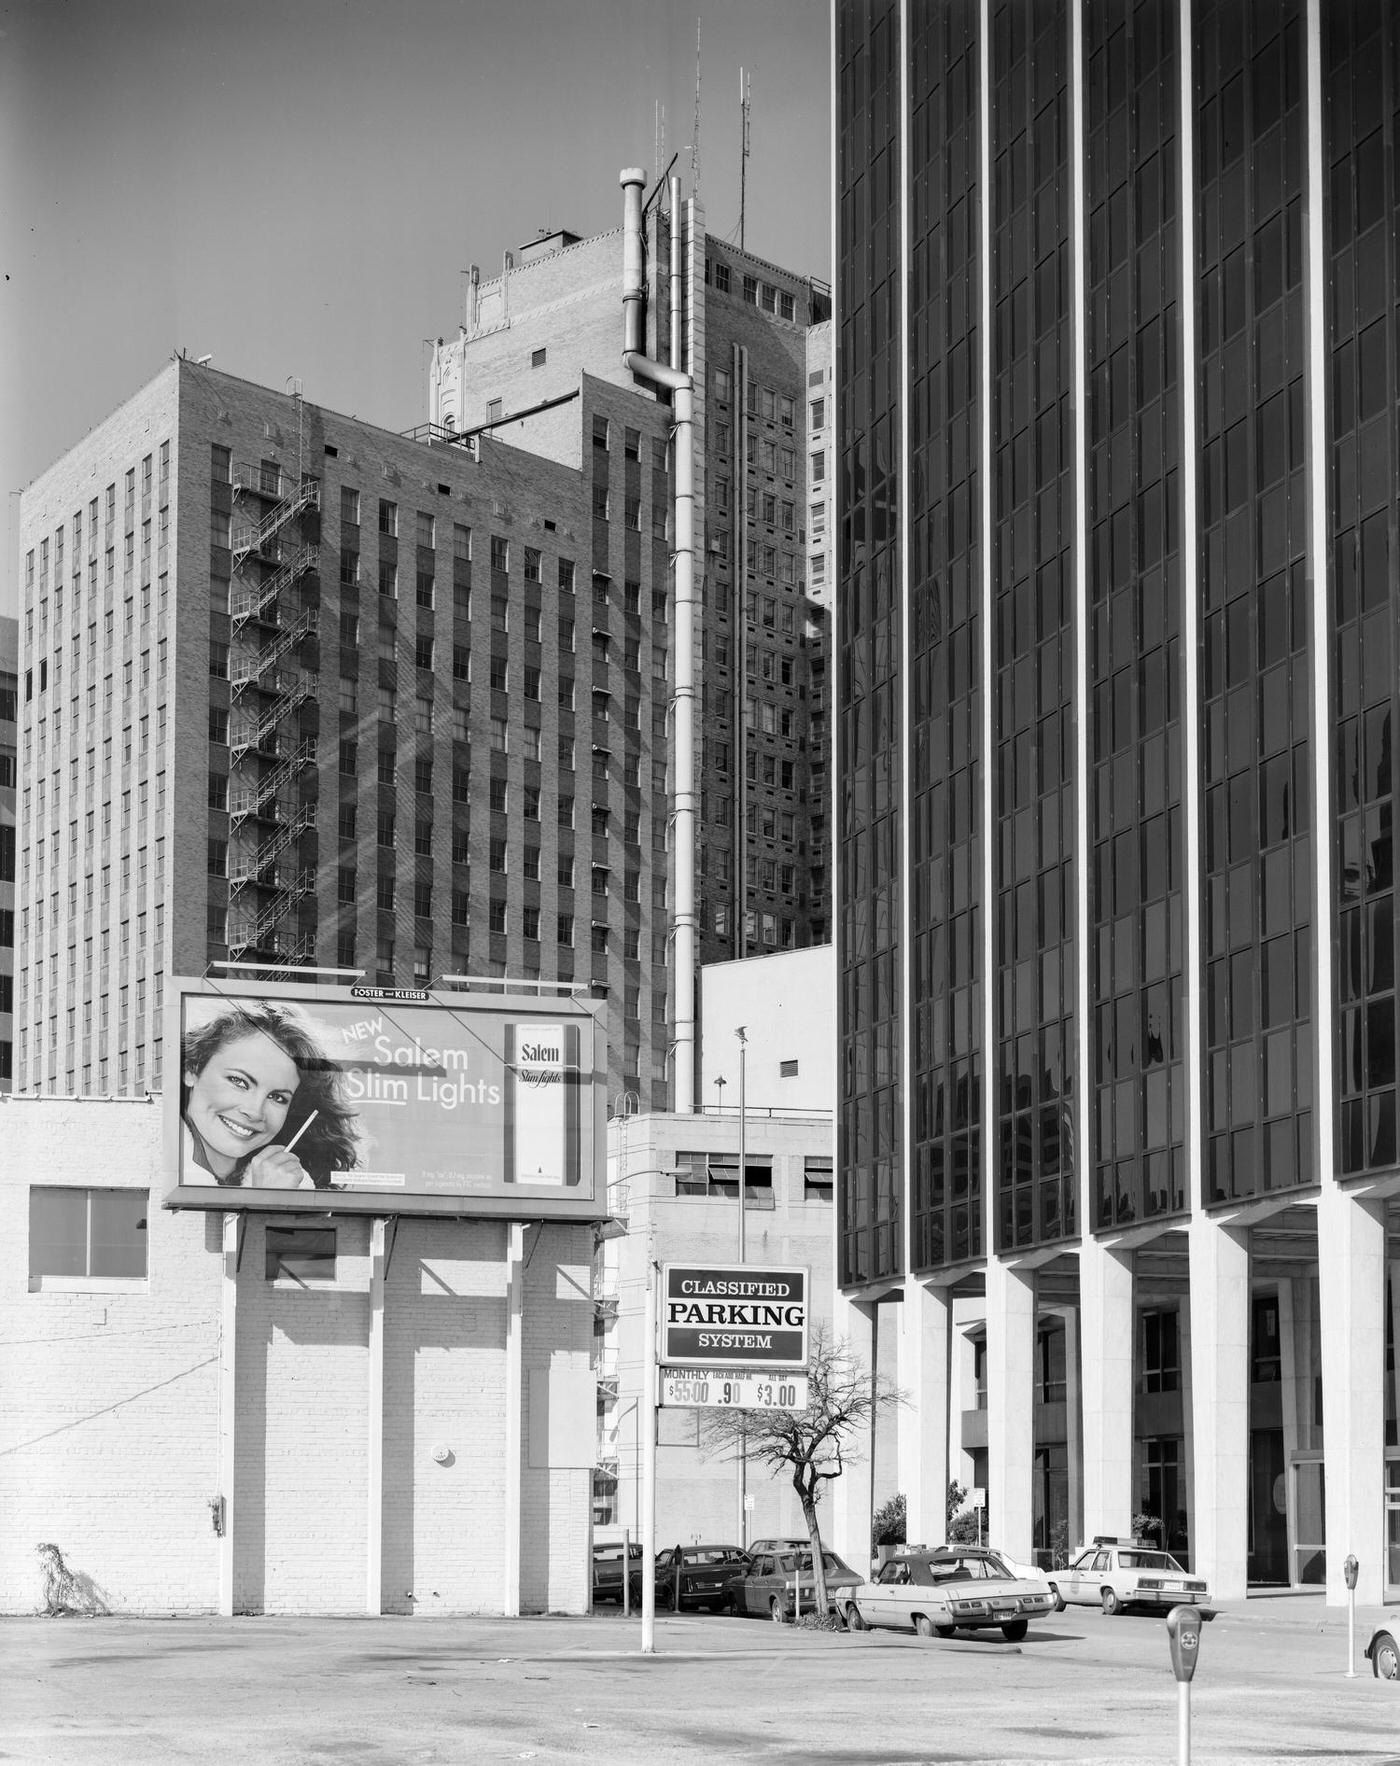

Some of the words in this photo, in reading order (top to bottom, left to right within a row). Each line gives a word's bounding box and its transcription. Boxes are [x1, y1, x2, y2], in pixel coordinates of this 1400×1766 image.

[354, 988, 383, 997] FOSTER
[395, 990, 426, 999] KLEISER
[341, 1017, 383, 1043] NEW
[374, 1035, 468, 1070] Salem
[521, 1043, 559, 1062] Salem
[519, 1069, 538, 1083] Slim
[346, 1067, 408, 1100] Slim
[417, 1071, 500, 1109] Lights
[681, 1280, 790, 1297] CLASSIFIED
[667, 1302, 805, 1326] PARKING
[698, 1333, 772, 1349] SYSTEM
[664, 1369, 709, 1380] MONTHLY
[757, 1384, 796, 1407] $3.00
